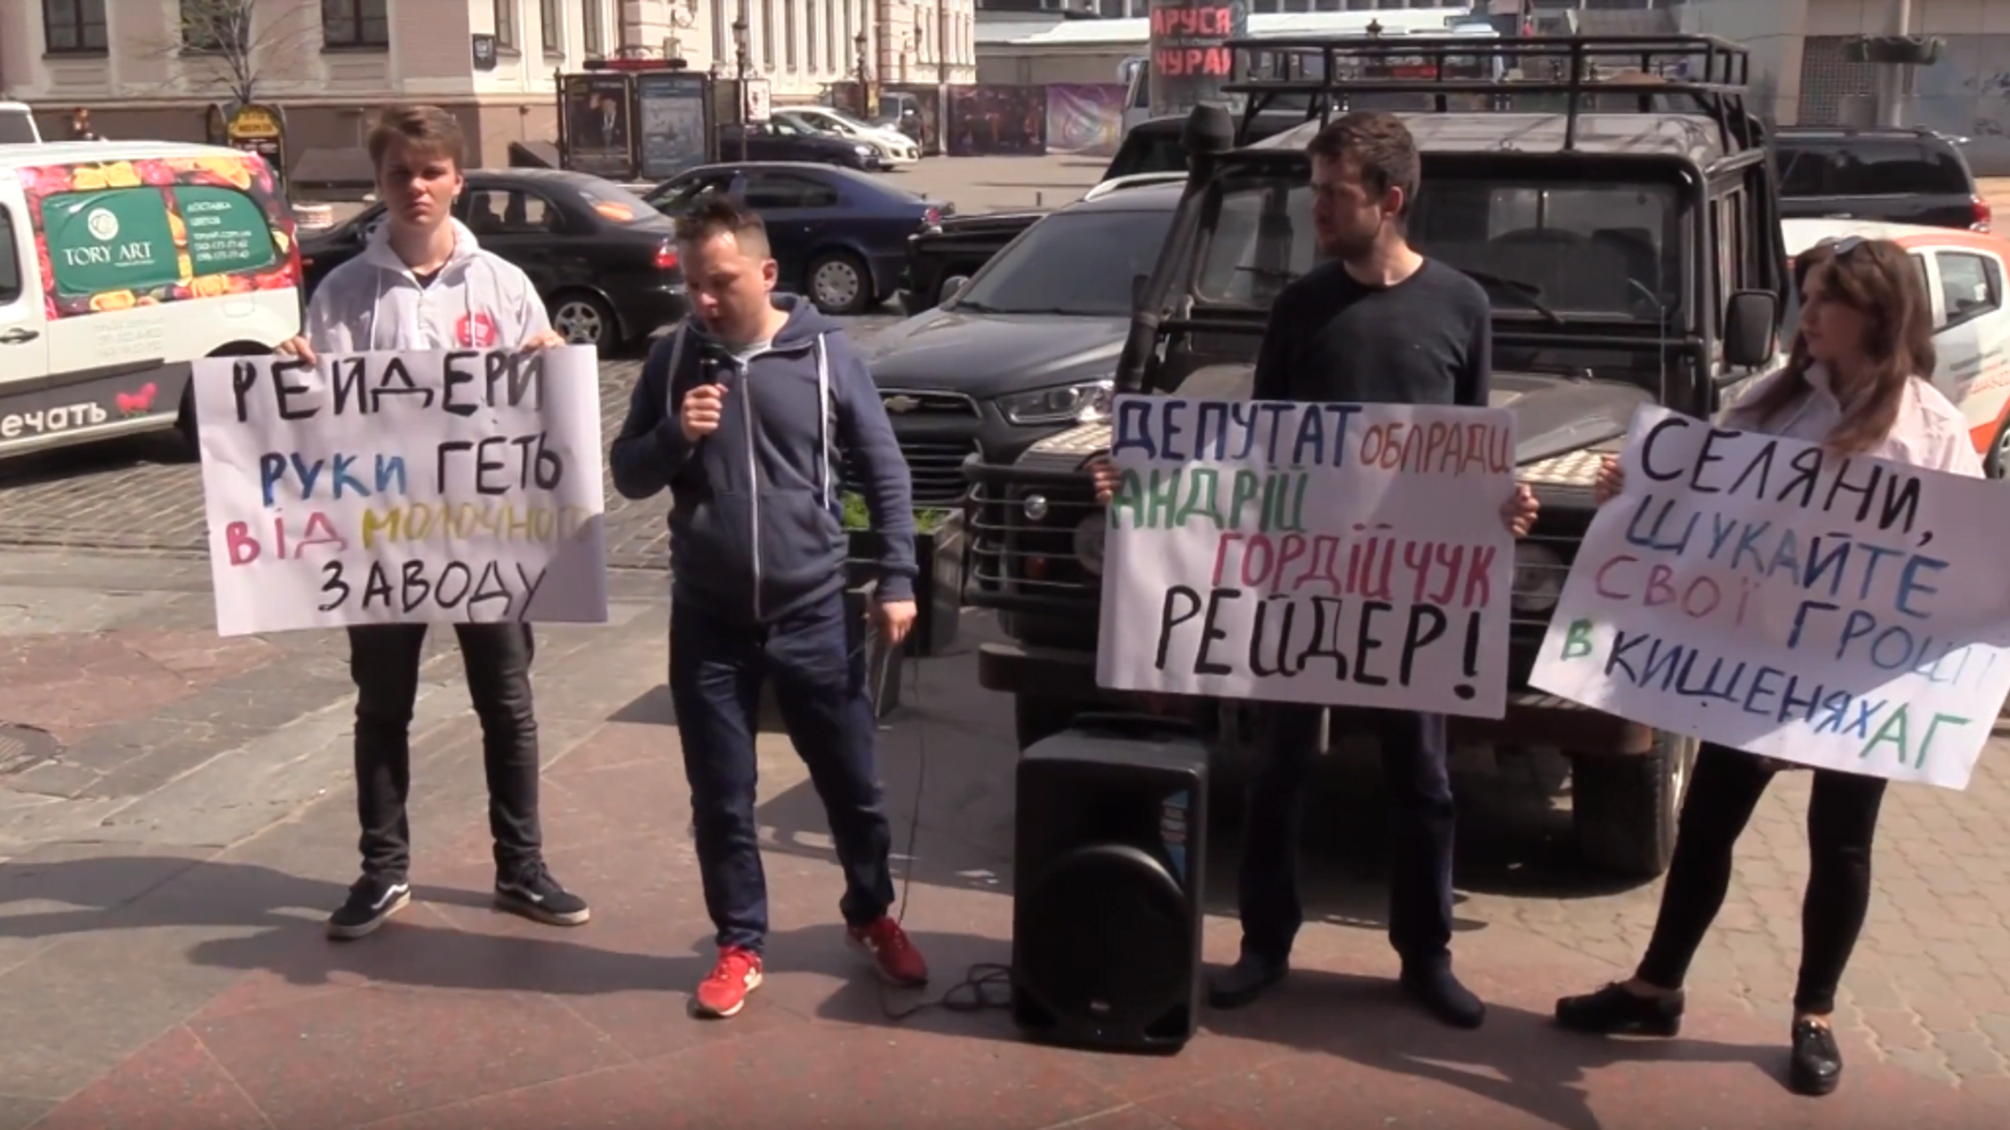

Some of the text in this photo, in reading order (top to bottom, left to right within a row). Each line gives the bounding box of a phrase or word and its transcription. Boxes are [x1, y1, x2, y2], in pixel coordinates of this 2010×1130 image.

[61, 241, 153, 267] TORY ART
[0, 401, 107, 438] ечать
[1111, 400, 1511, 477] ДЕПУТАТ ОБЛРАДИ
[260, 430, 563, 506] РУКИ ГЕТЬ
[1111, 464, 1309, 533] АНДРІЙ
[225, 508, 349, 567] ВІД
[1211, 522, 1497, 609] ГОРДІЙЧУК
[318, 559, 547, 623] ЗАВОДУ
[1594, 554, 1760, 627] СВОЇ
[1560, 619, 1594, 661] В
[1860, 702, 1974, 770] АГ
